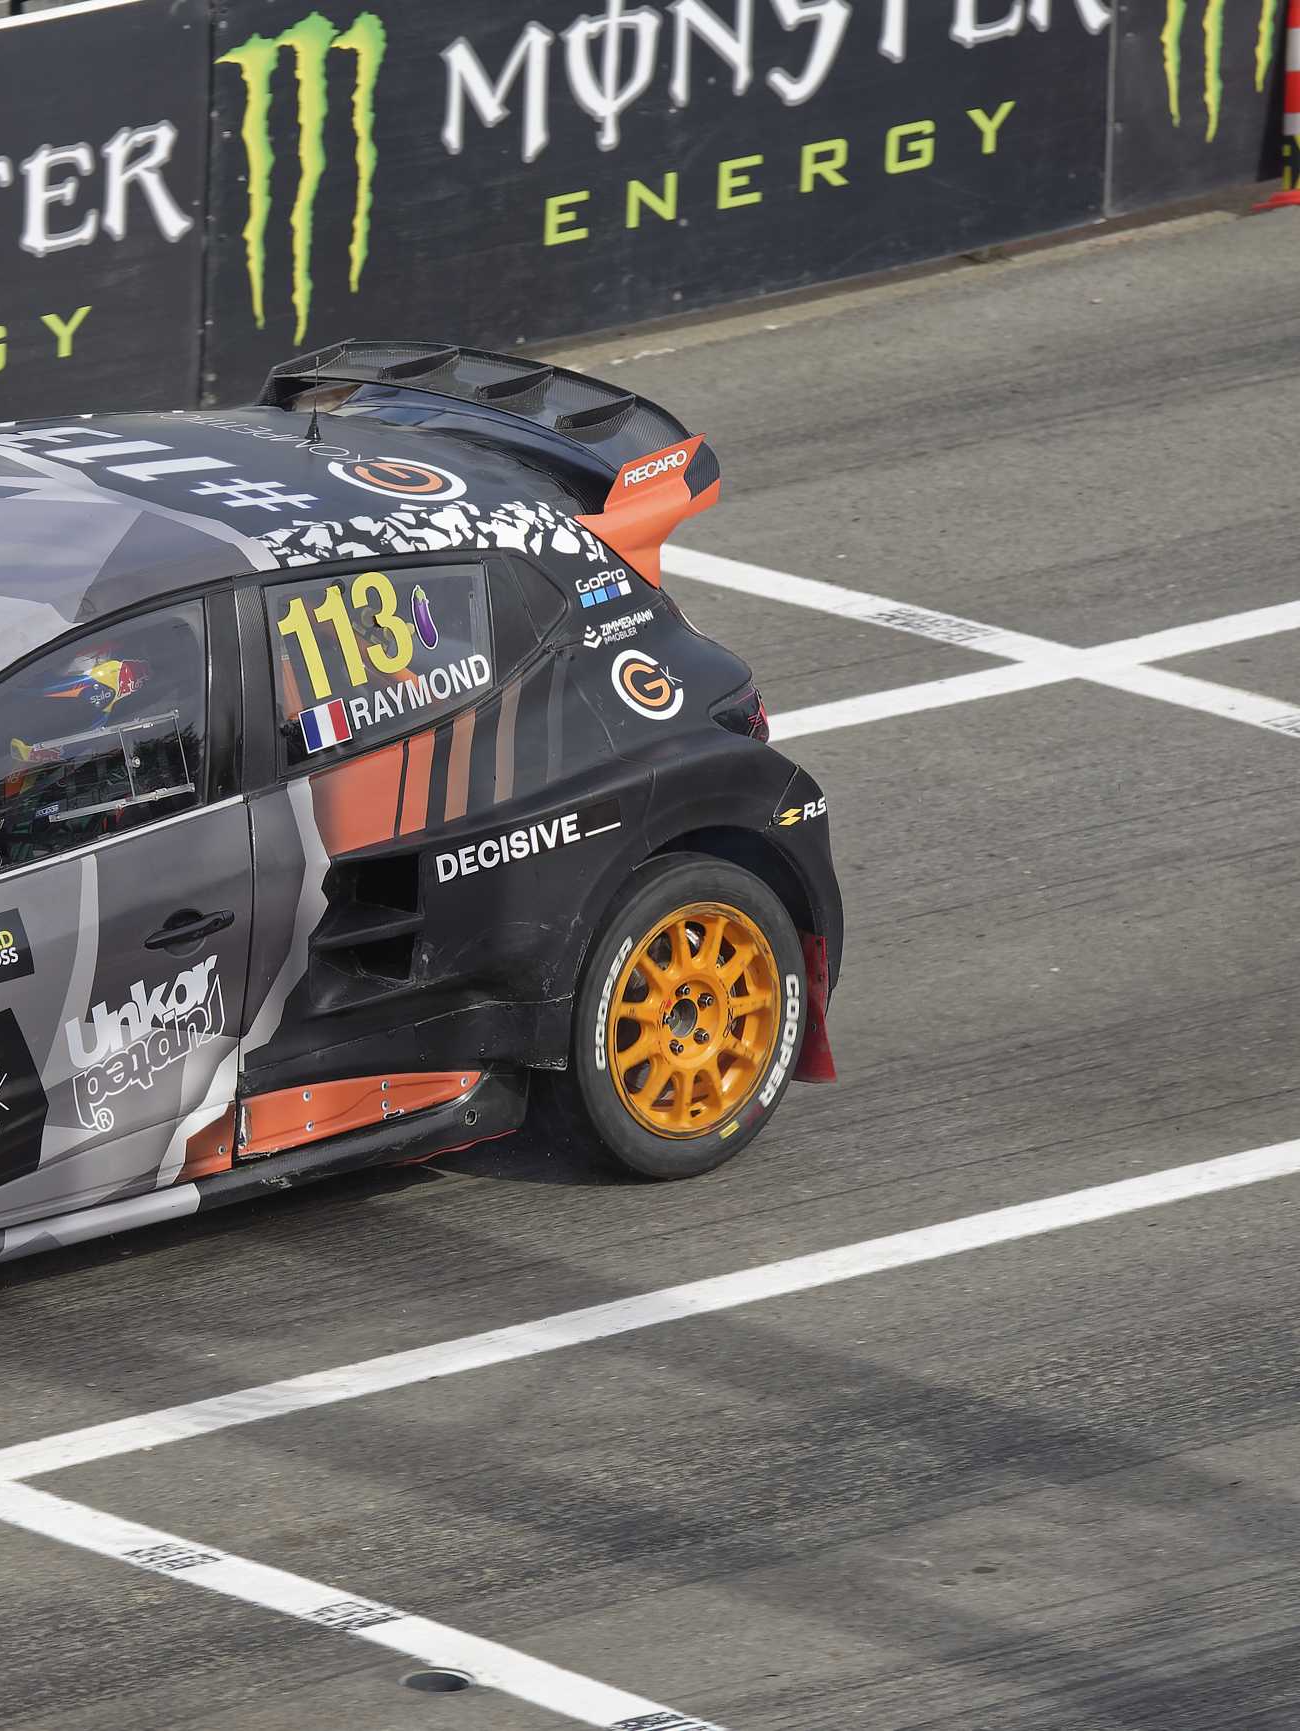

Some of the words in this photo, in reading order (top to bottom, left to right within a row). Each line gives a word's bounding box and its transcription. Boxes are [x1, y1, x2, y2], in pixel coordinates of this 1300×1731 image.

[440, 0, 1112, 163] MONS
[543, 100, 1016, 246] ENERGY
[623, 449, 688, 488] RECARO
[277, 571, 413, 699] 113
[575, 568, 627, 593] GoPro
[349, 653, 491, 730] RAYMOND
[758, 973, 800, 1108] COOPER
